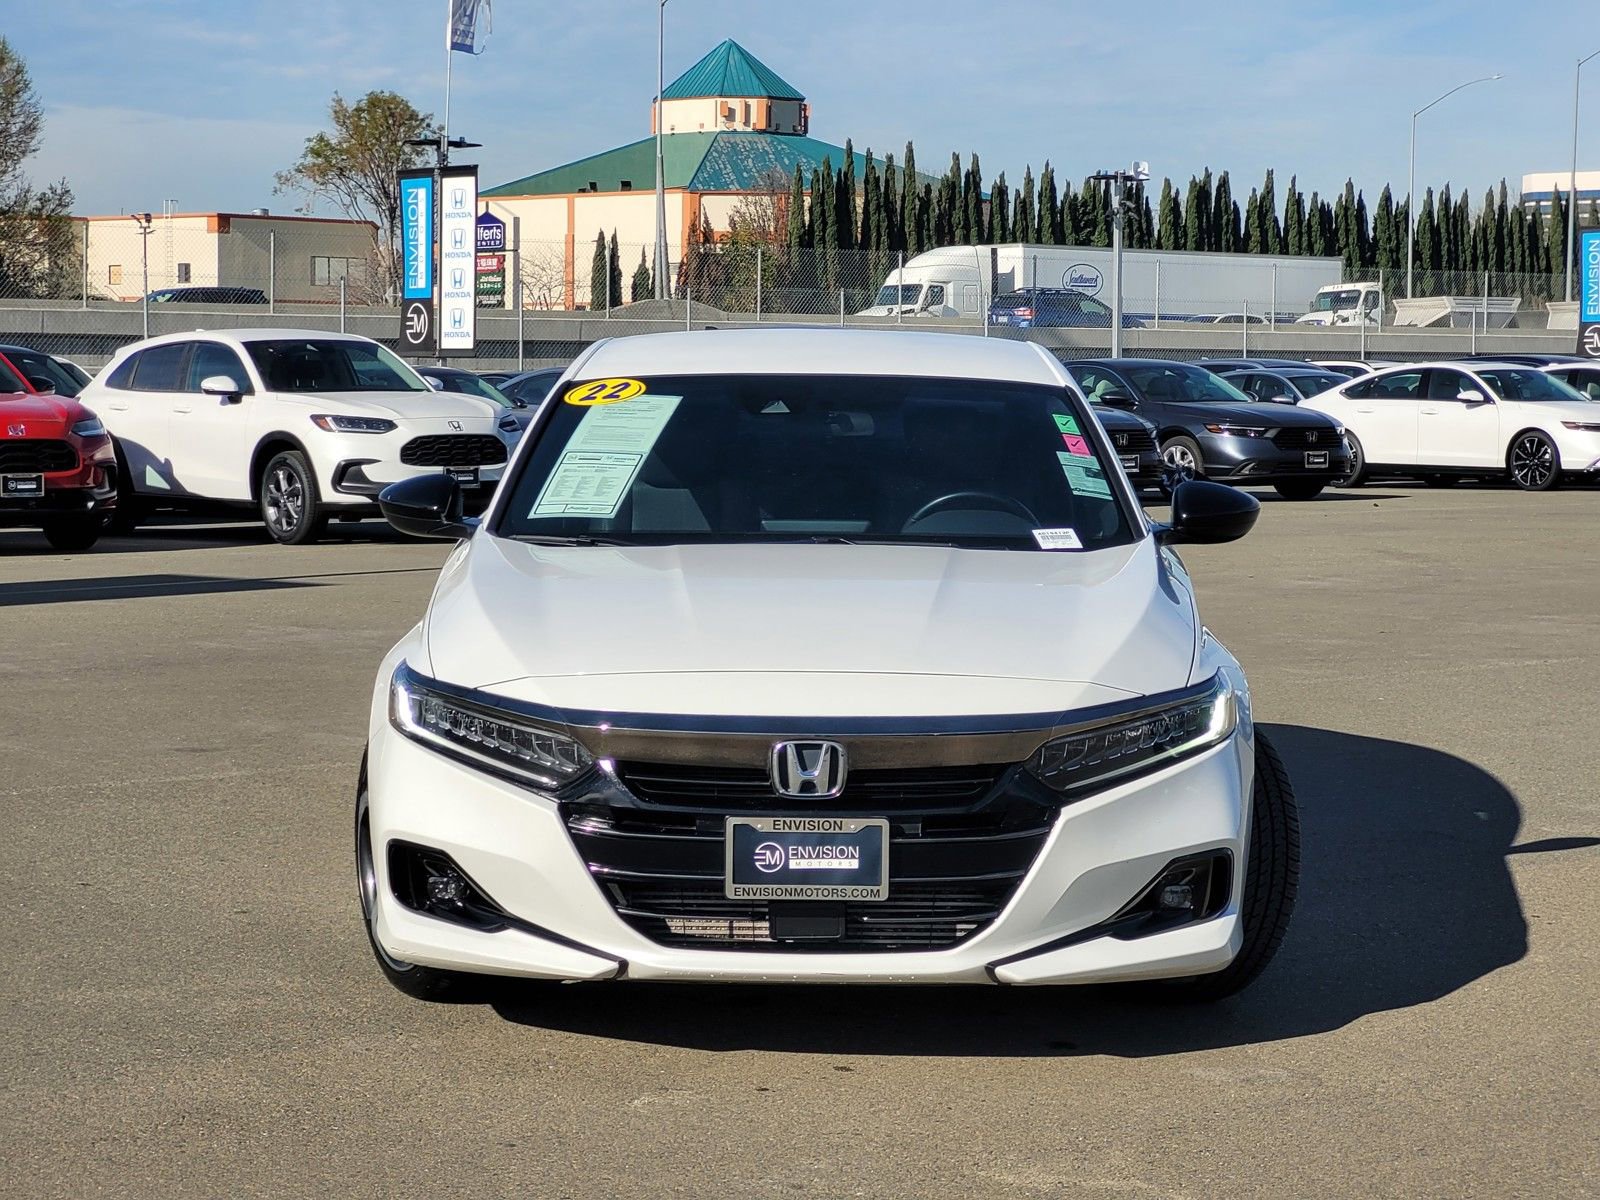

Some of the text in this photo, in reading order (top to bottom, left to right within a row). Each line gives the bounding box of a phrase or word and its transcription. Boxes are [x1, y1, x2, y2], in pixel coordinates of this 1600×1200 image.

[407, 188, 418, 289] ENVISION
[477, 226, 501, 241] lferts
[1587, 240, 1600, 316] ENVISION
[579, 382, 631, 400] 22
[772, 819, 843, 831] ENVISION
[788, 845, 859, 859] ENVISION
[733, 887, 880, 899] ENVISIONMOTORS.COM
